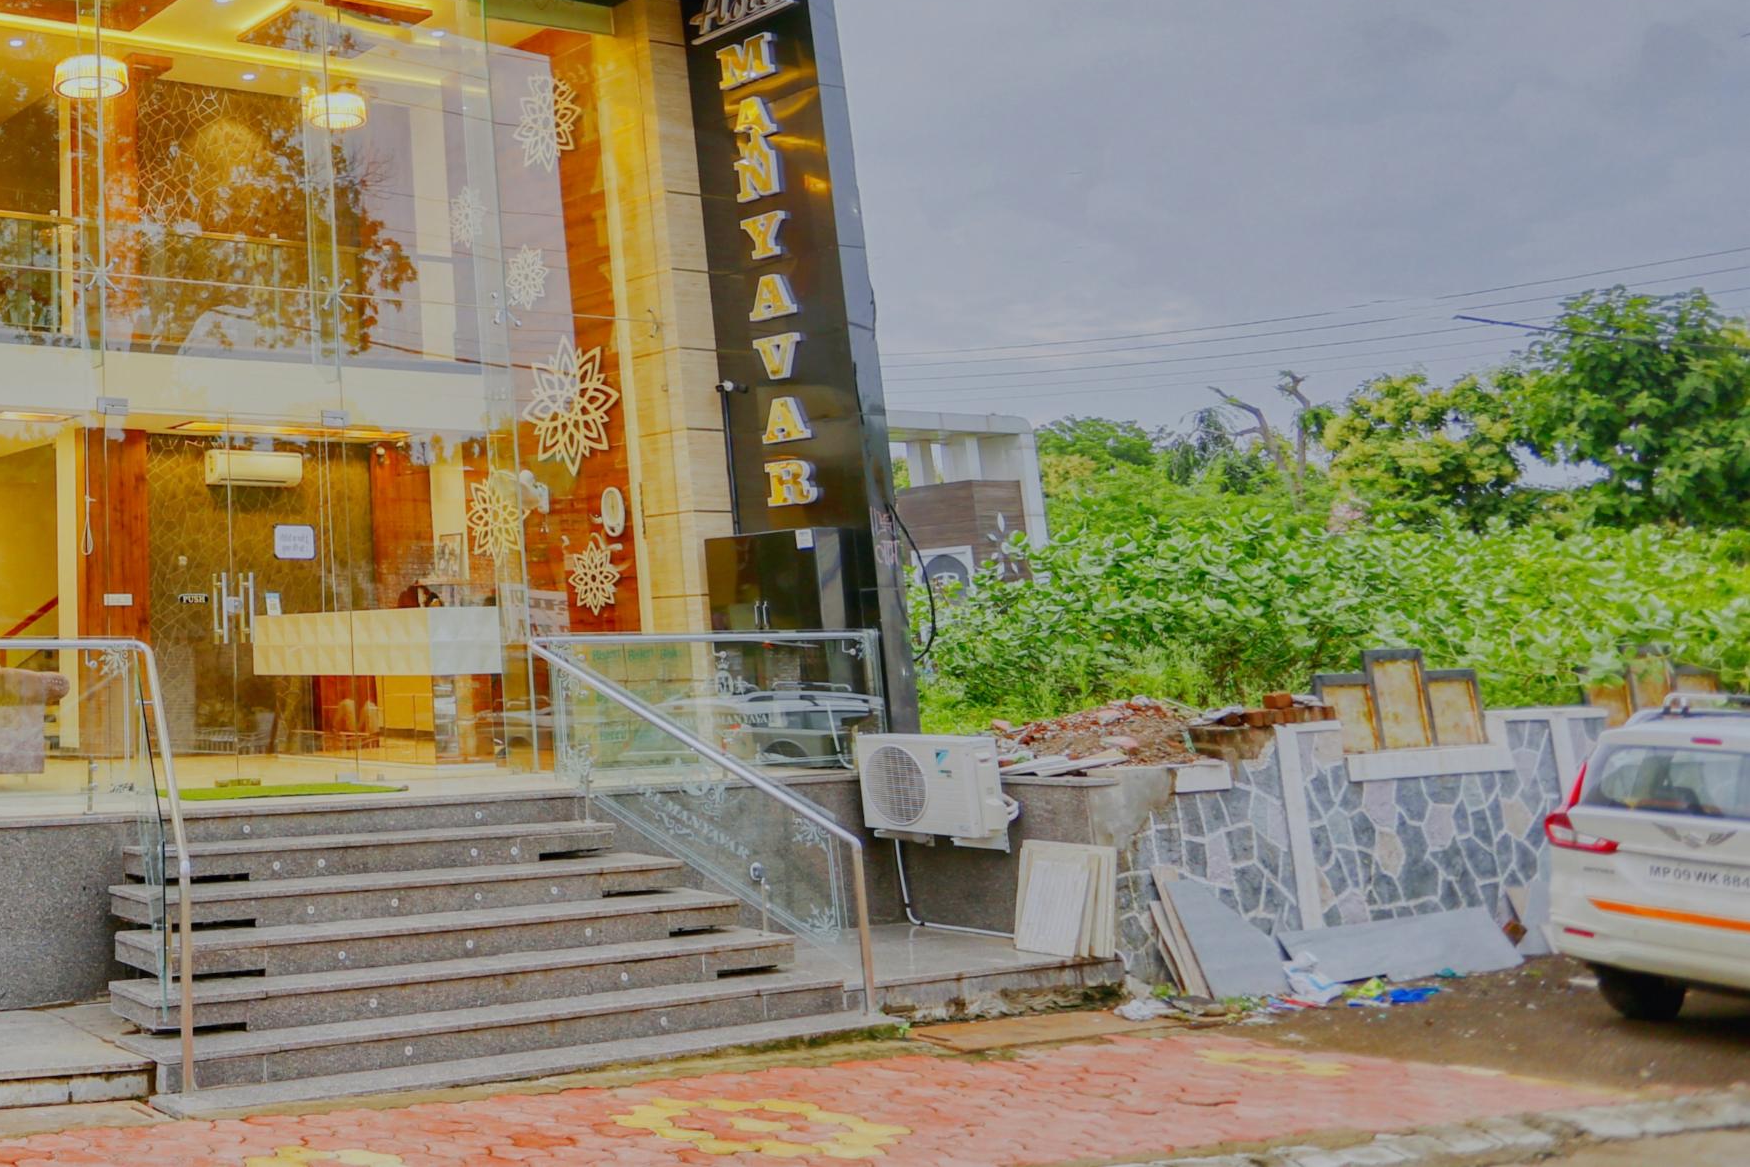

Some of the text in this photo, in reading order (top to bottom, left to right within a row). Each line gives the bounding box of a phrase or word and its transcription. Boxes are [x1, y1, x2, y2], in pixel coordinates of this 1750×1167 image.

[715, 31, 820, 507] MANYAVAR
[182, 595, 206, 603] PUSH
[715, 712, 778, 726] MANYAVA
[1649, 865, 1671, 878] MP
[1674, 867, 1691, 881] 09
[1694, 870, 1721, 886] WK
